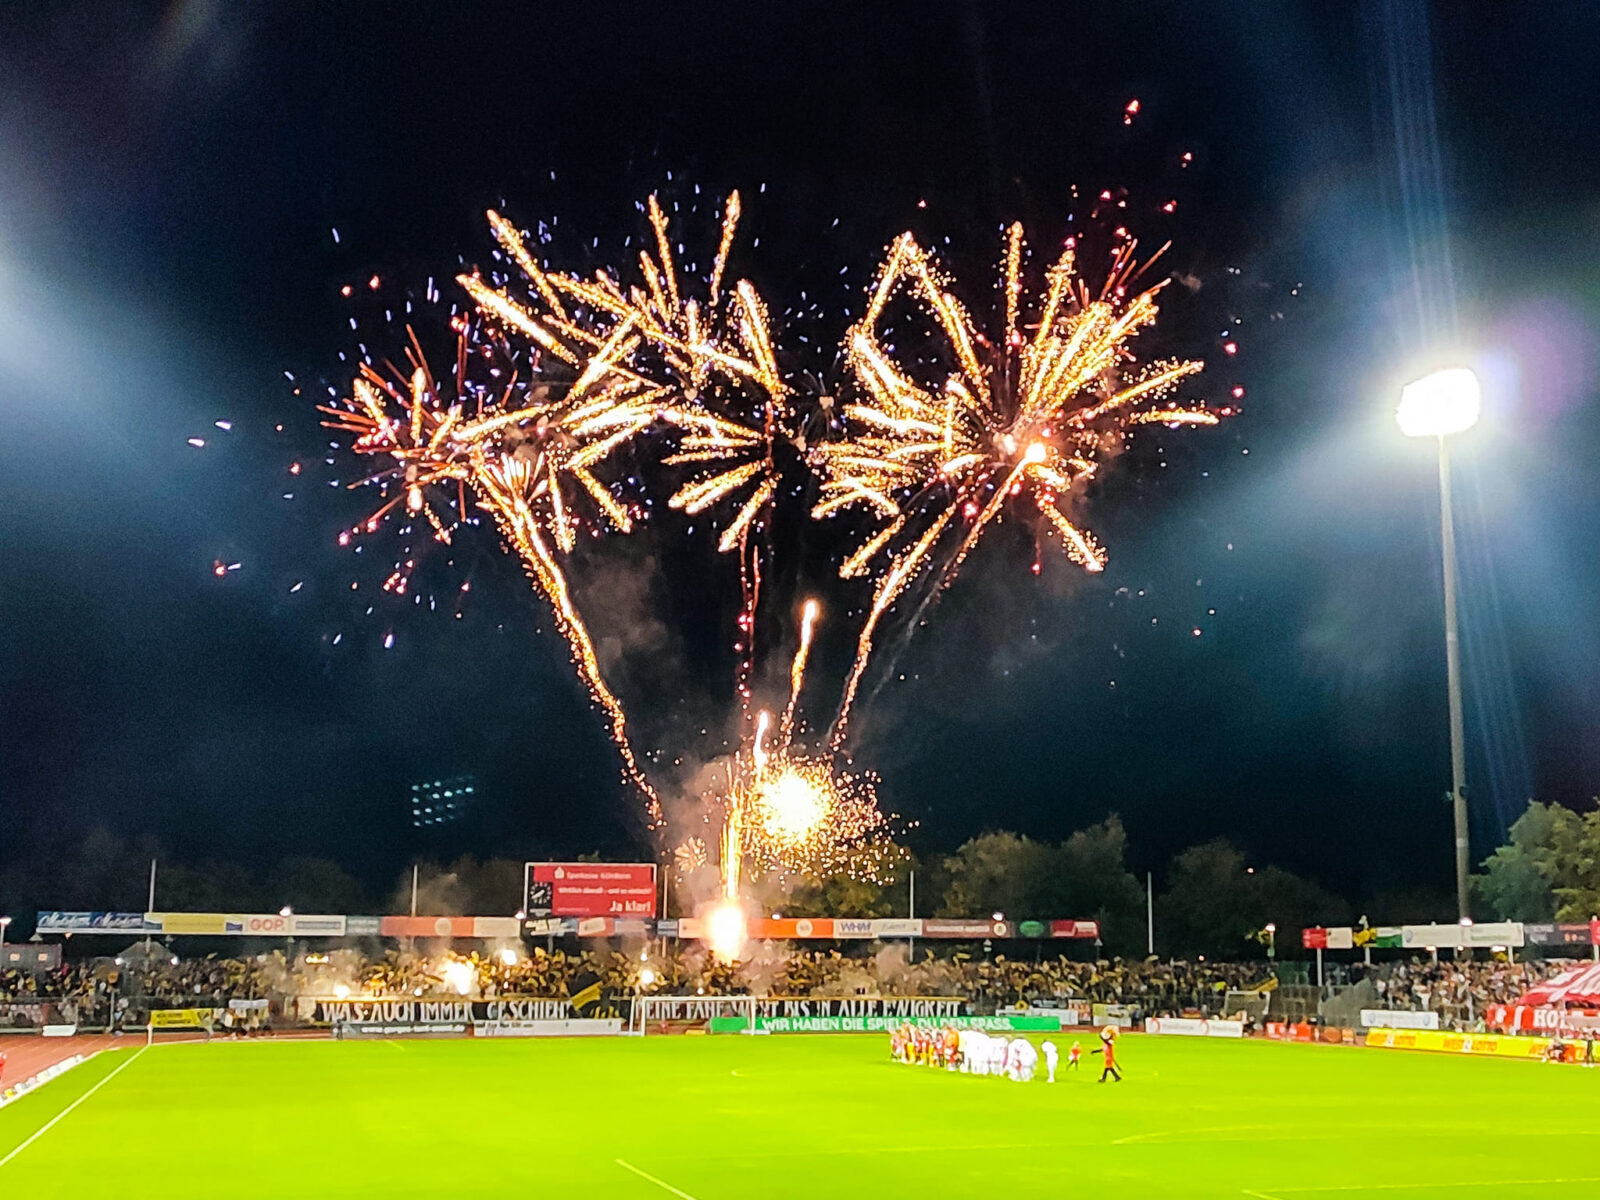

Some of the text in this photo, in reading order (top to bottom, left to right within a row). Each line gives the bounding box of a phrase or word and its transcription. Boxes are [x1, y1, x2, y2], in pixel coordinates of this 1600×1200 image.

[609, 899, 651, 912] Ja klar!
[321, 1002, 365, 1022] WAS
[369, 1001, 415, 1022] AUCH
[419, 1001, 475, 1022] IMMER
[784, 999, 810, 1017] BIS
[816, 999, 831, 1017] IN
[838, 999, 878, 1017] ALLE
[883, 999, 961, 1017] EWIGKEIT
[762, 1018, 790, 1030] WIR
[792, 1018, 840, 1030] HABEN
[842, 1018, 866, 1031] DIE
[940, 1018, 968, 1030] DEN
